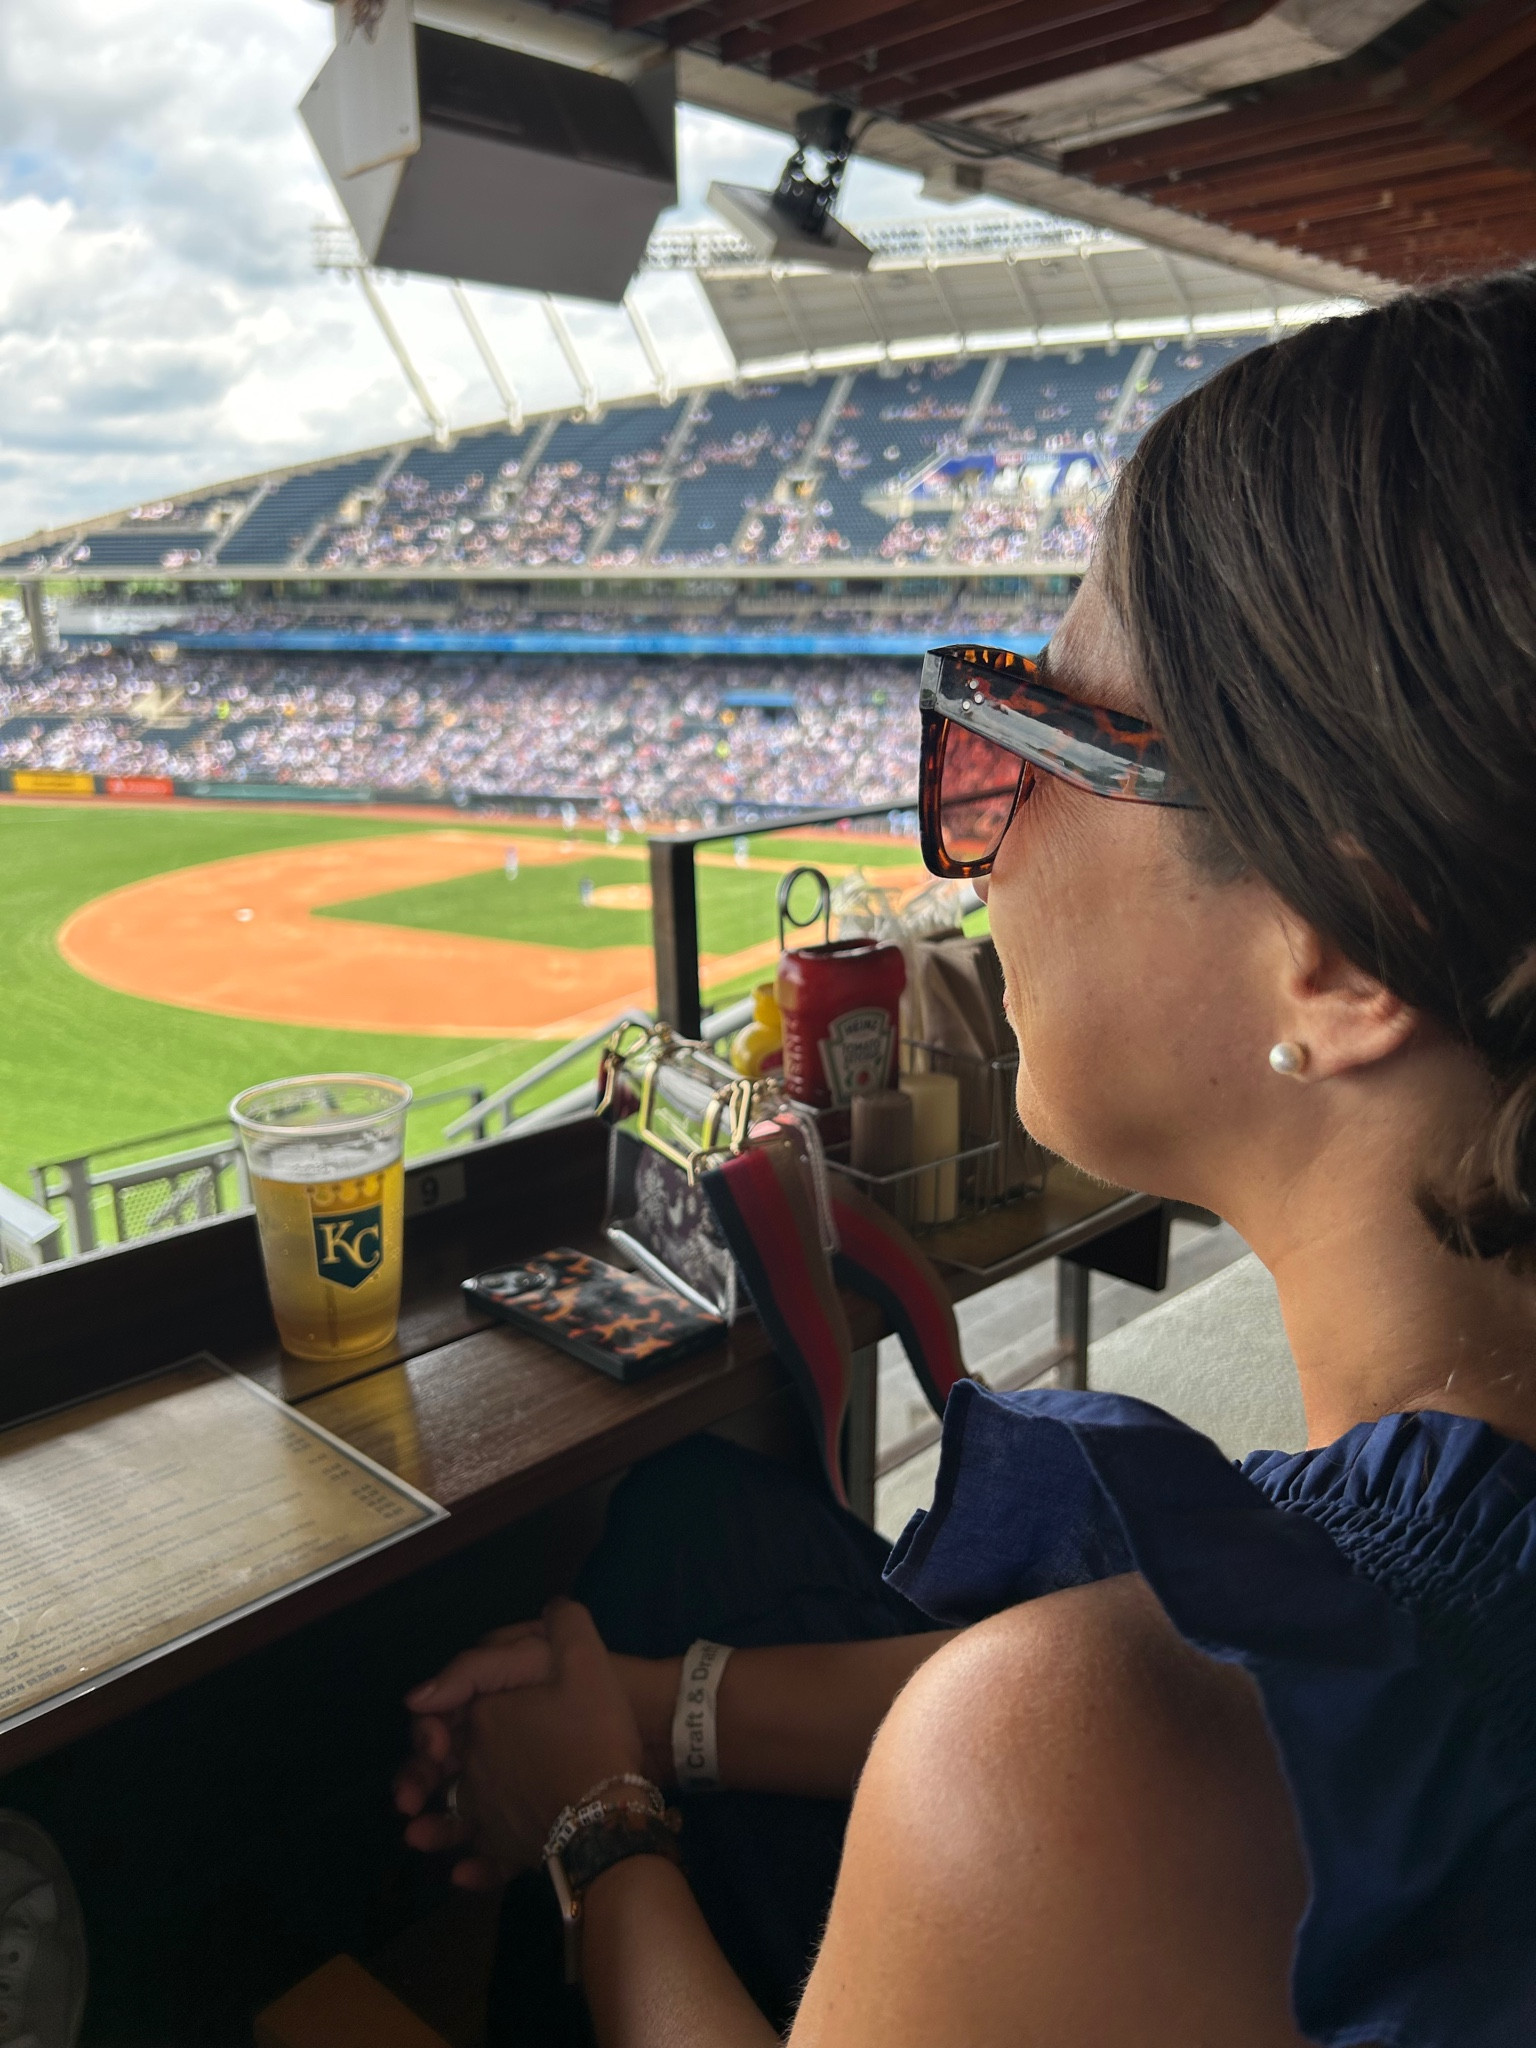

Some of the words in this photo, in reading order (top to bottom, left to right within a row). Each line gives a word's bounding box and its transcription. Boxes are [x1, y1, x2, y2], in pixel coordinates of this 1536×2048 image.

[320, 1220, 380, 1269] KC
[687, 1688, 704, 1703] &
[685, 1711, 705, 1769] Craft
